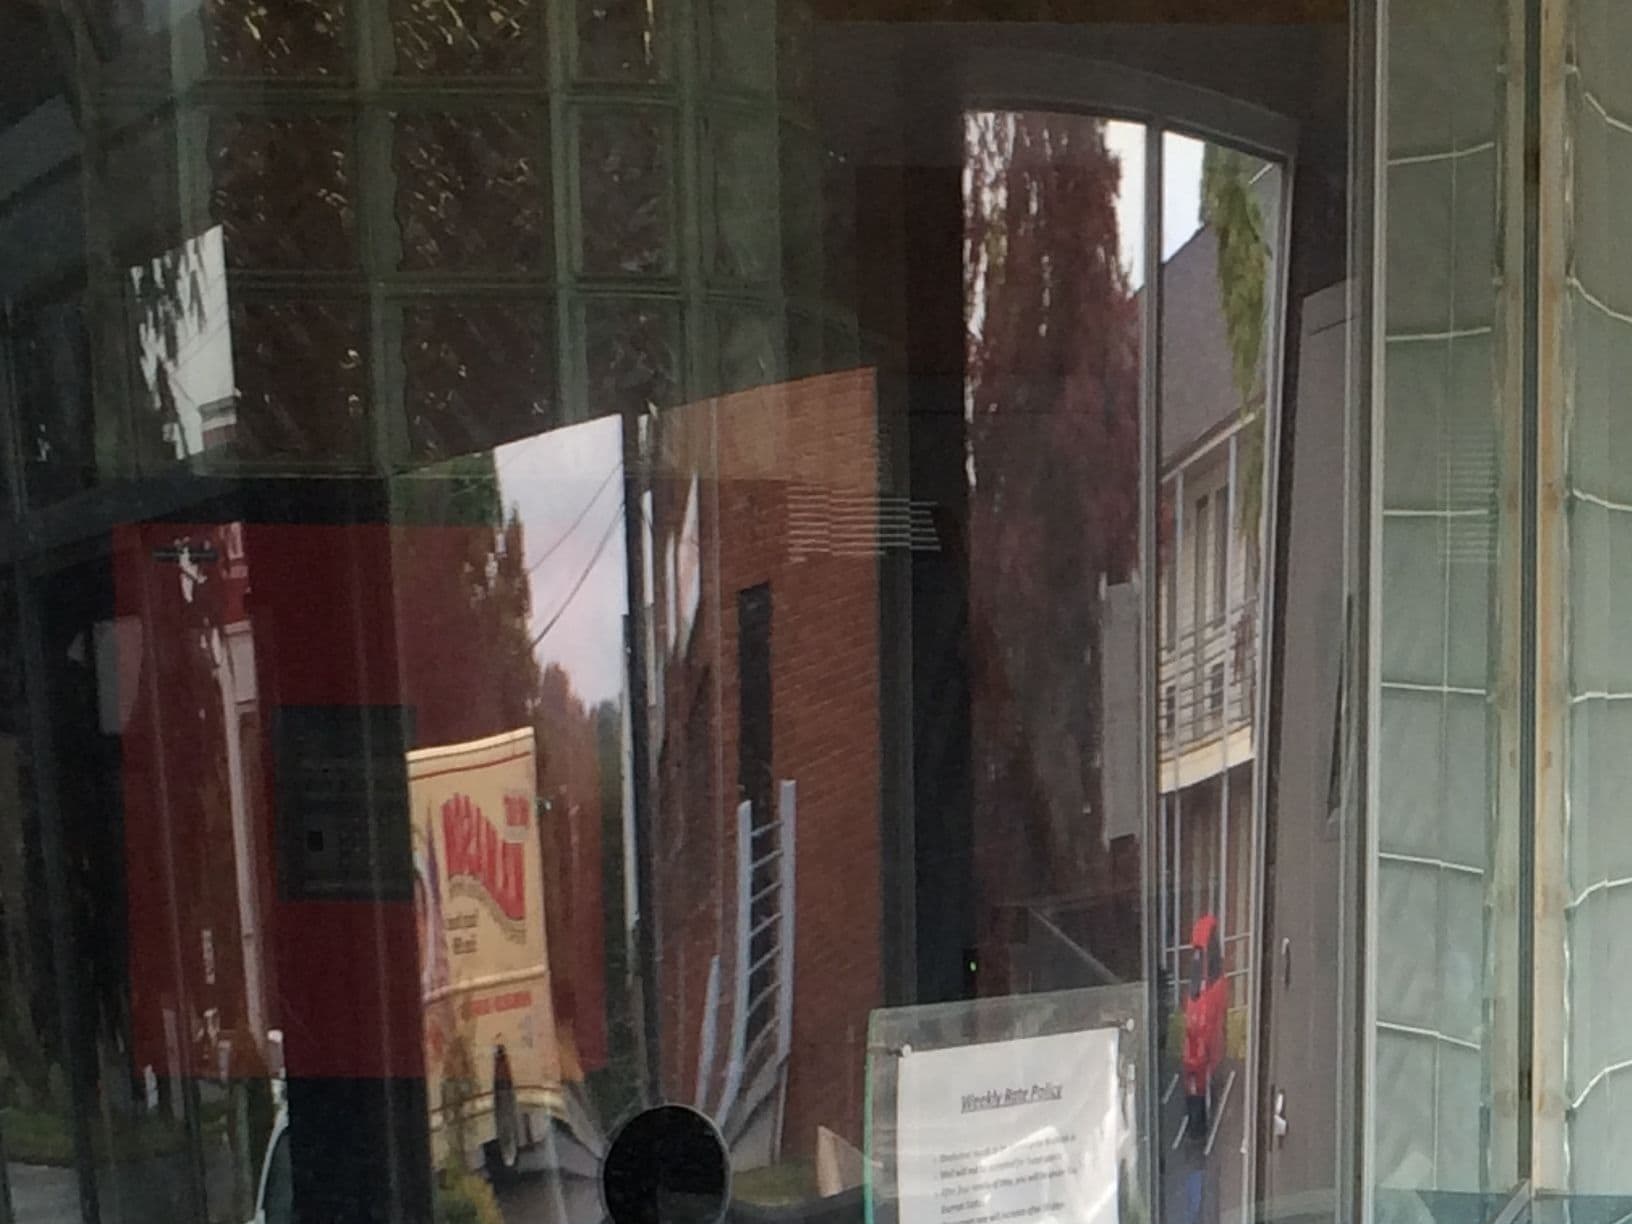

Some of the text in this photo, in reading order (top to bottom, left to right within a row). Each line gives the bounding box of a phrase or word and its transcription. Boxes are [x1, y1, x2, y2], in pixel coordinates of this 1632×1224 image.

[961, 1082, 1063, 1114] Weekly Rate Policy
